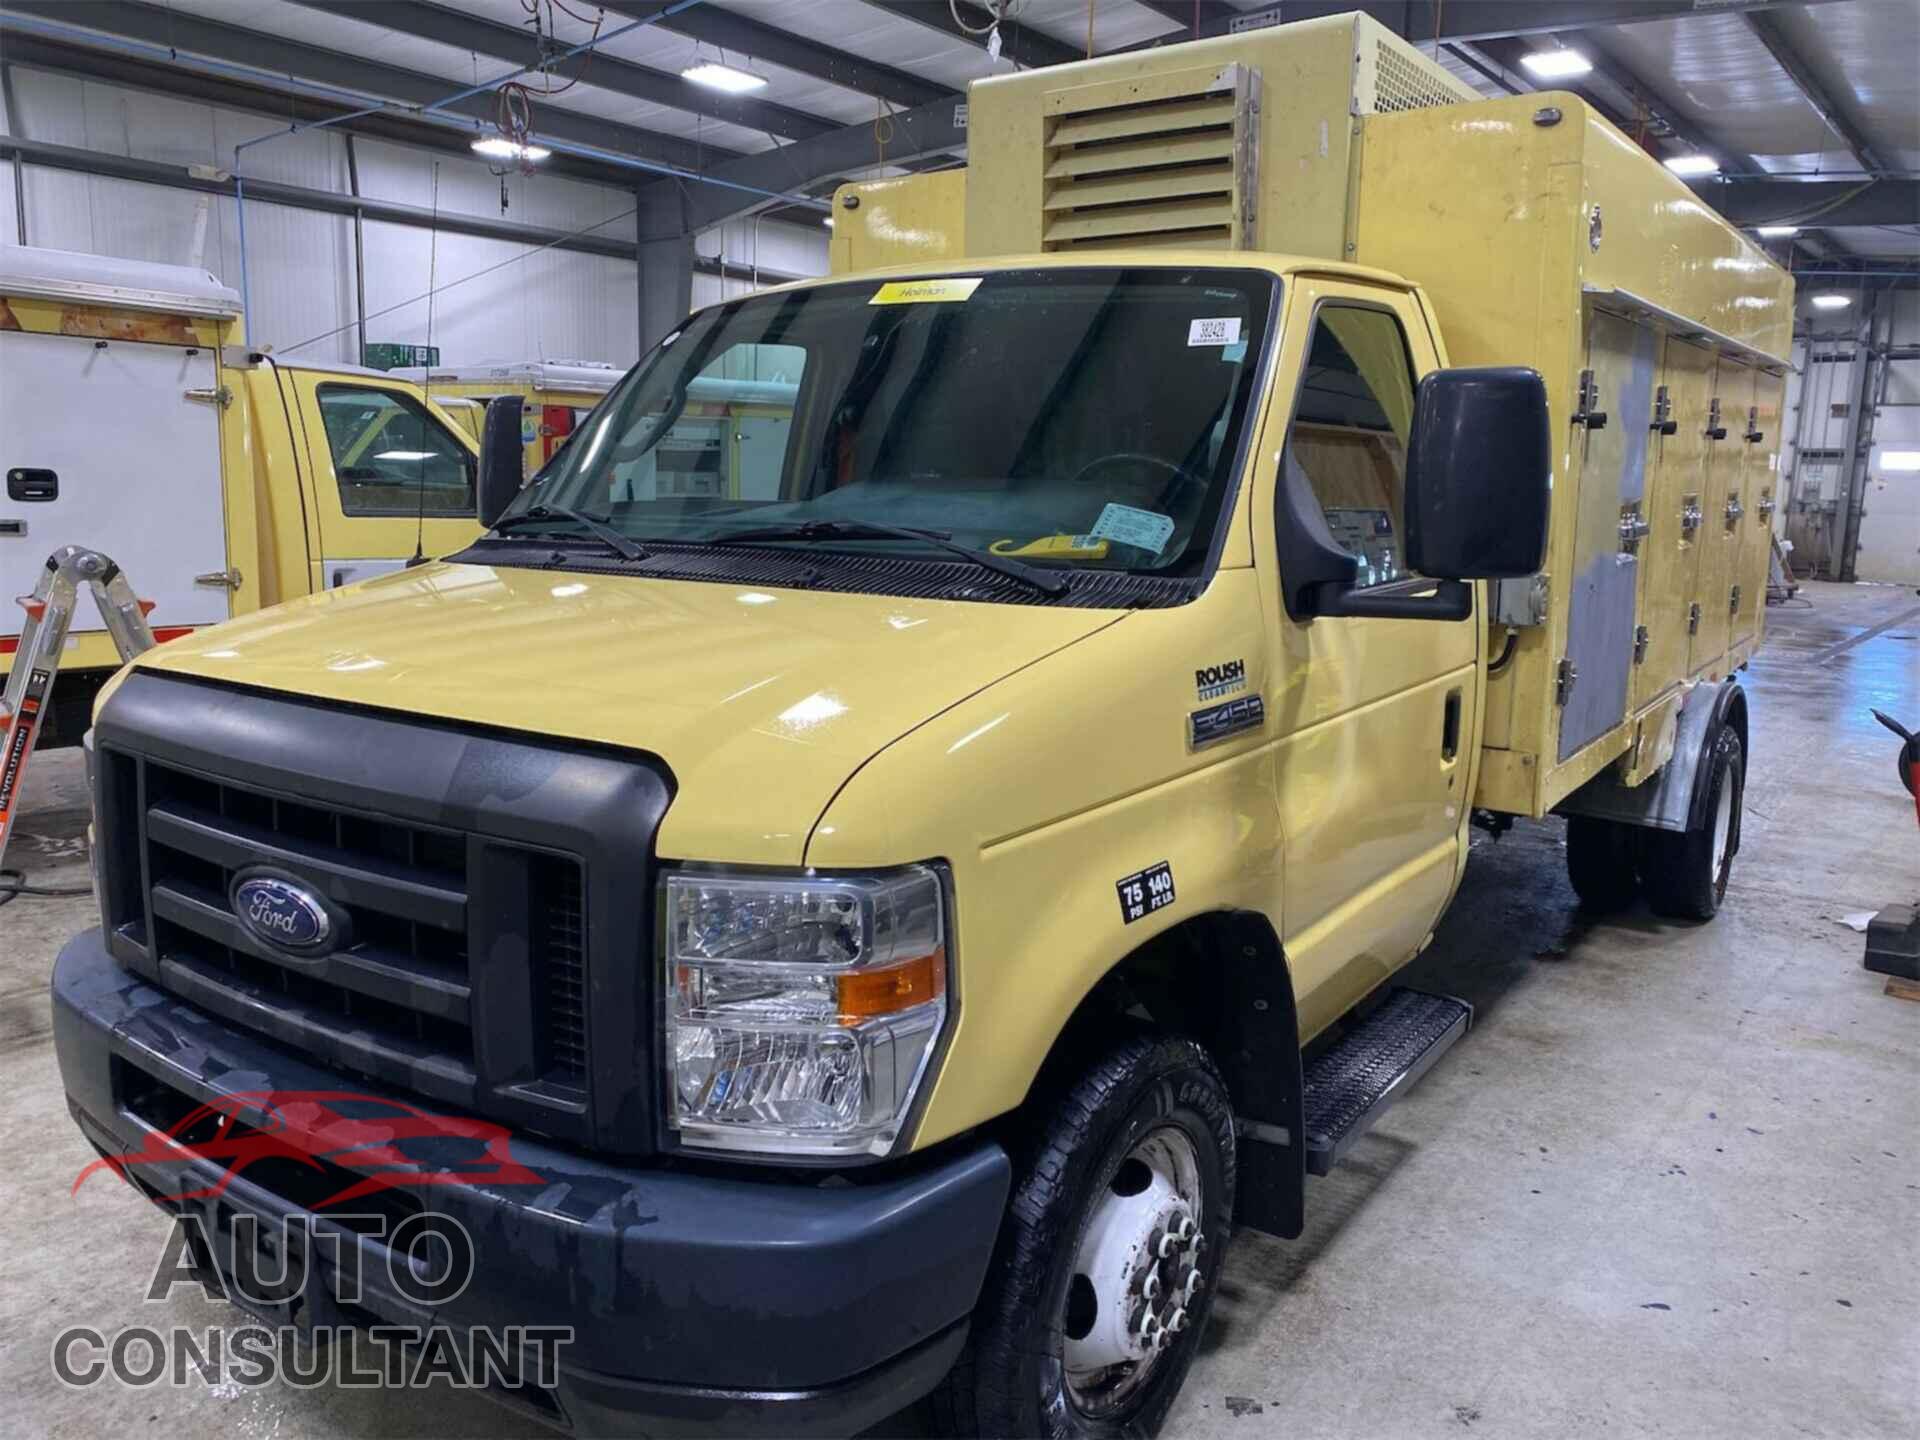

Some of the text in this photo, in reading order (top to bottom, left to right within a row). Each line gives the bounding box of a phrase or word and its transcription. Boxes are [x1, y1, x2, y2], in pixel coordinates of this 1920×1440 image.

[1195, 658, 1245, 689] ROUSH
[1123, 882, 1144, 906] 75
[1148, 871, 1172, 896] 140
[249, 890, 298, 934] Ford
[1130, 904, 1144, 919] PSI
